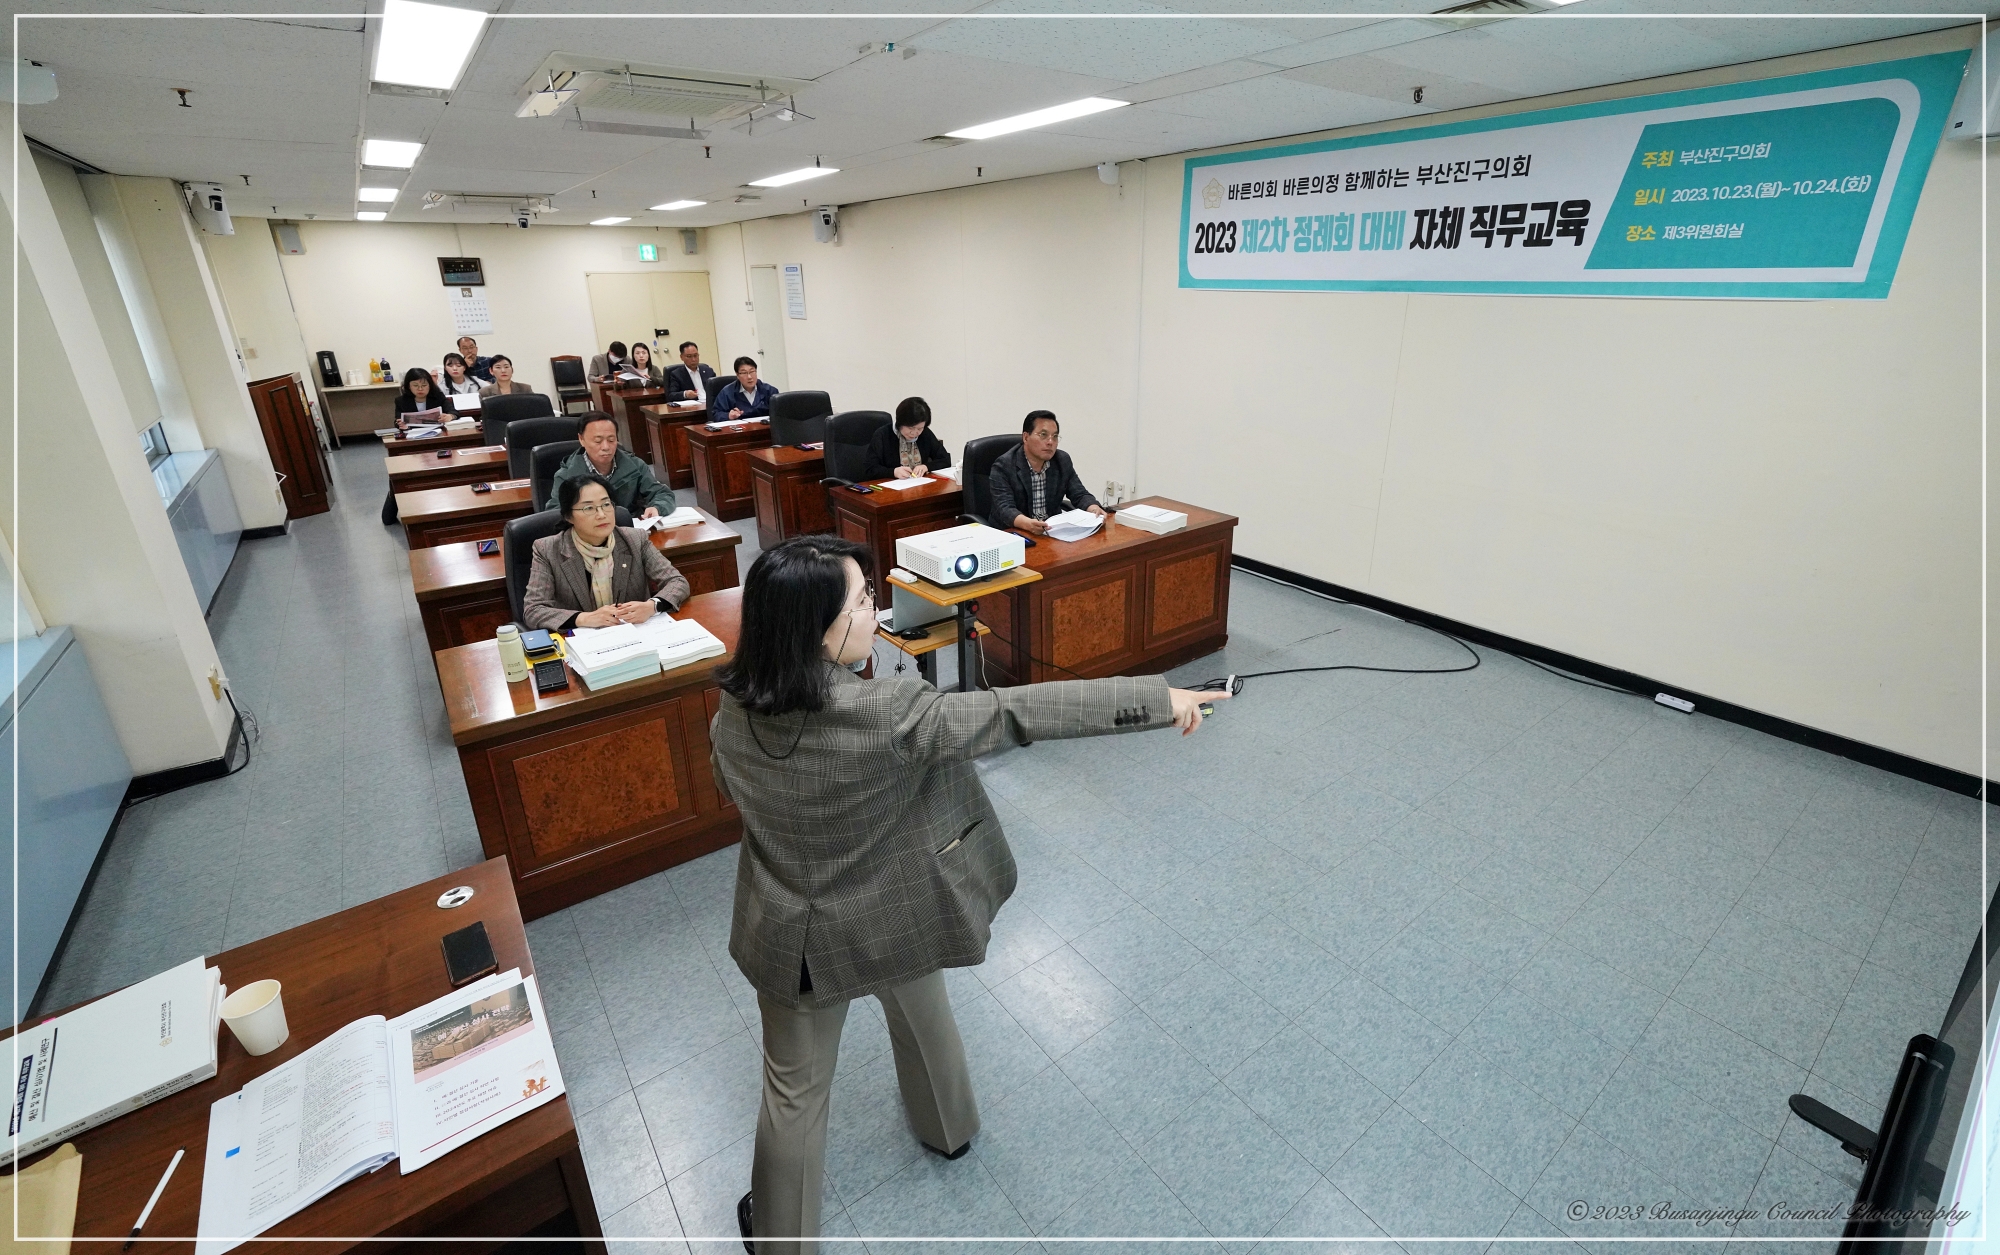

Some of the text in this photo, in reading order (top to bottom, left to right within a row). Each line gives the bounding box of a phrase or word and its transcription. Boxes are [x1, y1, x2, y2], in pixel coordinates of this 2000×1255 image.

[1641, 142, 1772, 169] 주최 부산진구의회
[1228, 154, 1532, 201] 바른의회 바른의정 함께하는 부산진구의회
[1634, 188, 1666, 206] 일시
[1194, 198, 1592, 254] 2023 제2차 정례회 대비 자체 직무교육
[1626, 223, 1745, 242] 장소 제3위원회실
